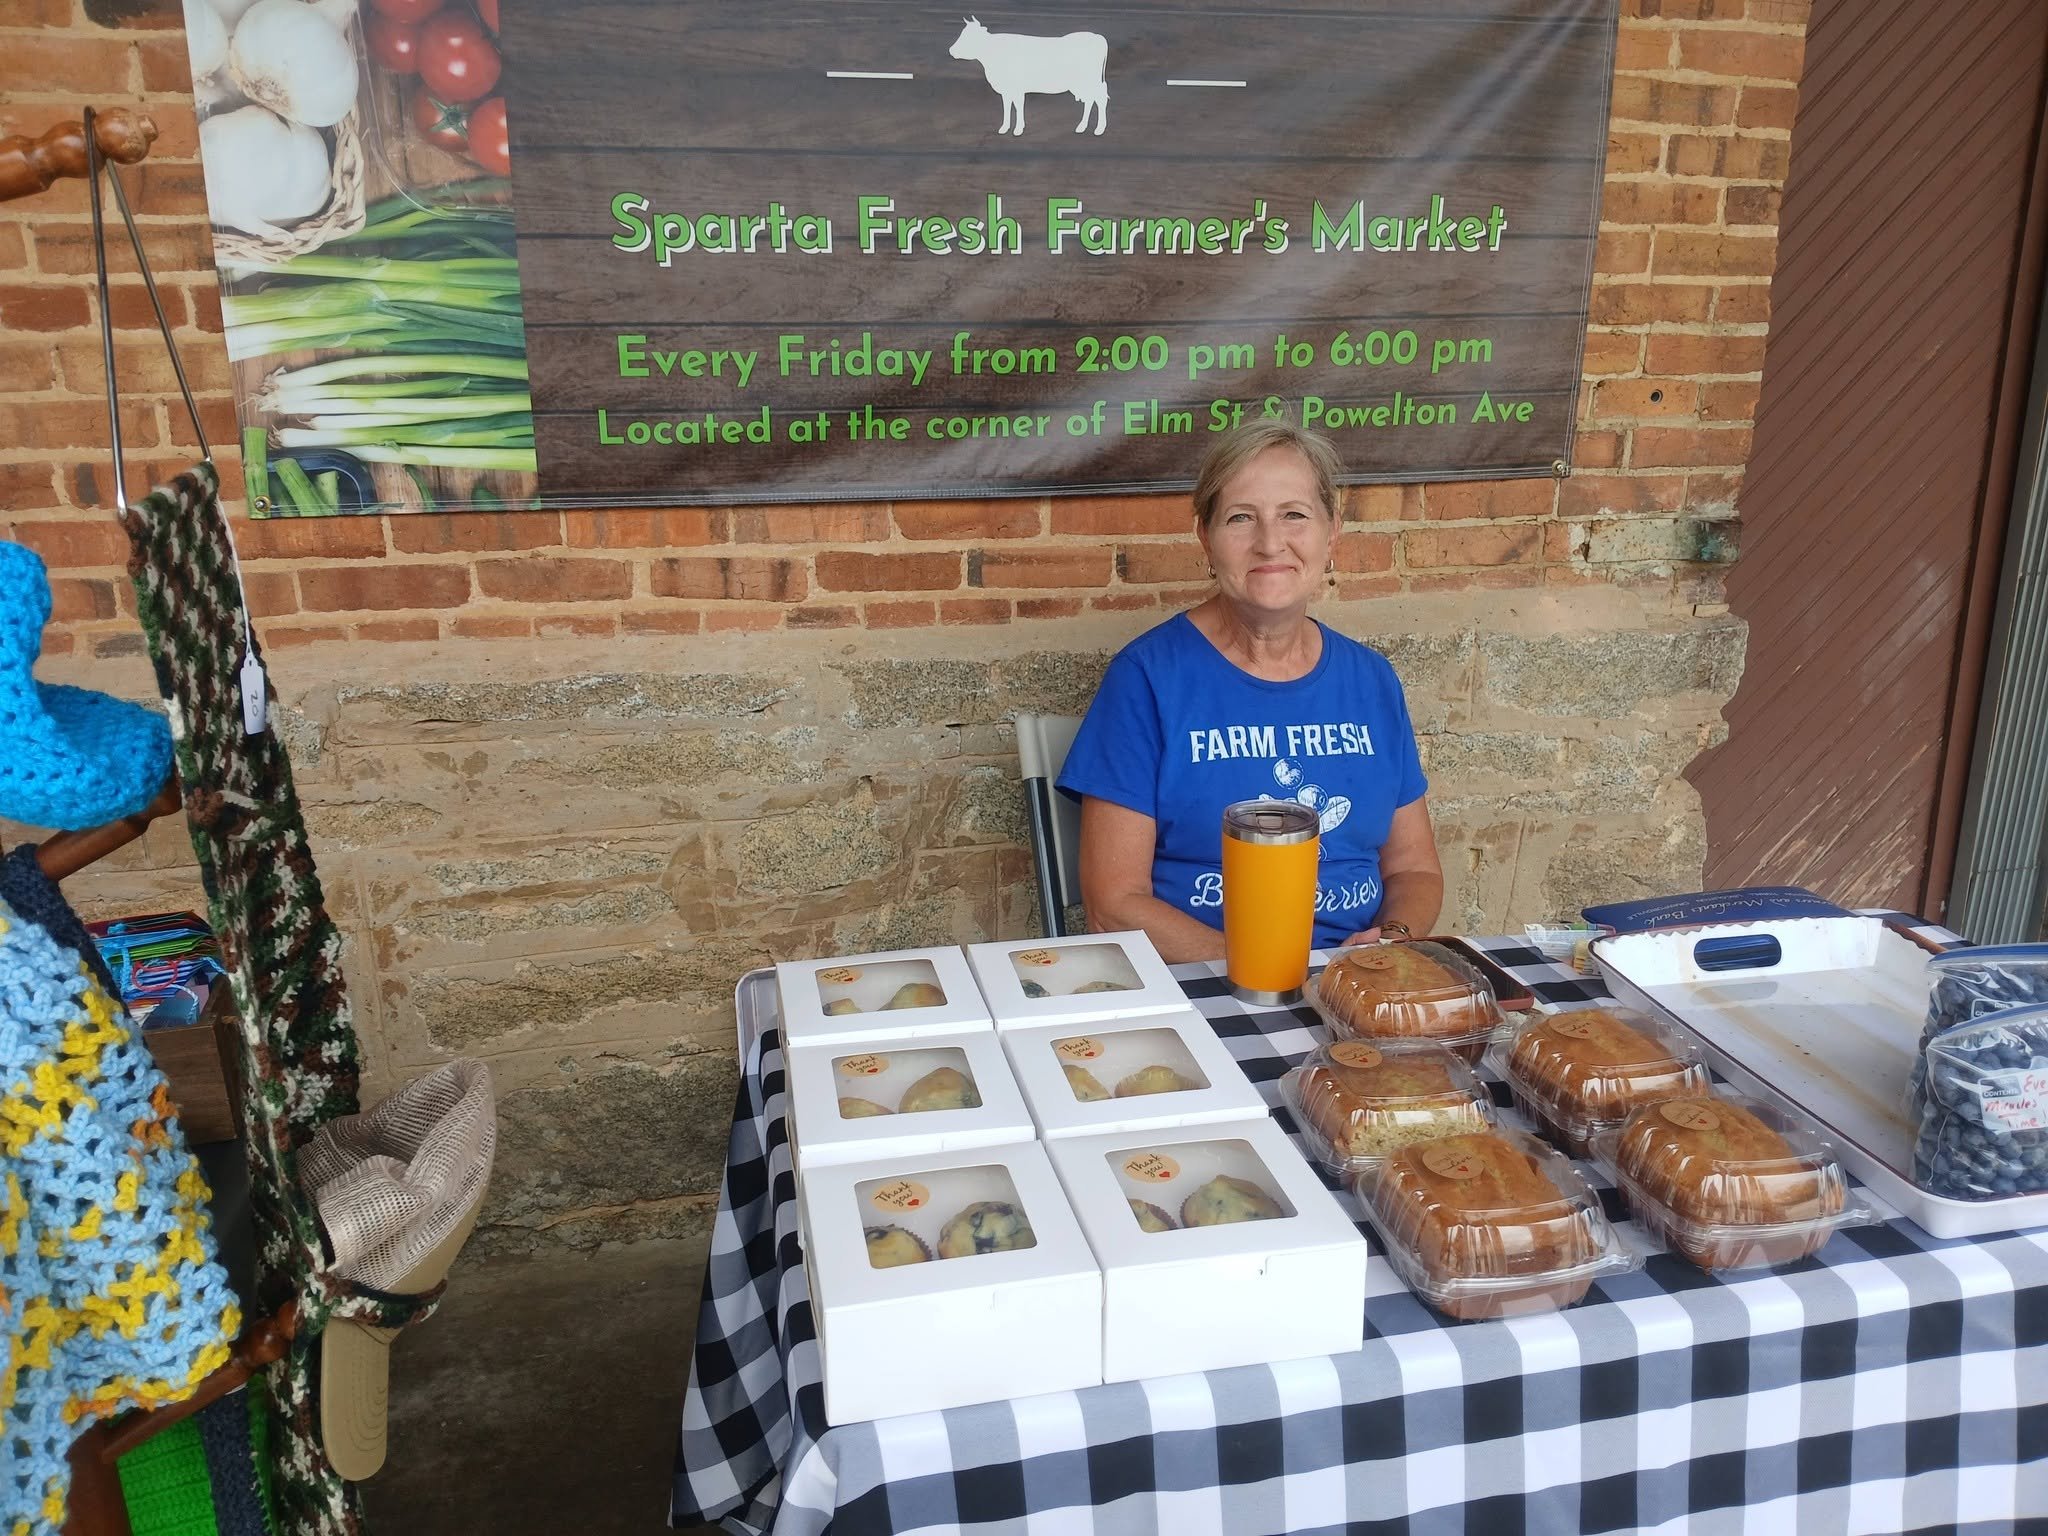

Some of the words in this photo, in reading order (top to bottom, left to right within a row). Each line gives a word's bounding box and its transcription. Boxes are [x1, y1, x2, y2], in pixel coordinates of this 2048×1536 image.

[610, 192, 832, 267] Sparta
[857, 193, 1022, 254] Fresh
[1047, 197, 1289, 255] Farmer's
[1311, 193, 1508, 252] Market
[617, 335, 758, 387] Every
[778, 332, 932, 386] Friday
[951, 332, 1056, 374] from
[1075, 335, 1169, 373] 2:00
[1188, 342, 1255, 380] pm
[1274, 334, 1315, 368] to
[1330, 330, 1419, 366] 6:00
[1431, 337, 1493, 374] pm
[598, 406, 771, 446] Located
[788, 411, 831, 441] at
[847, 404, 911, 441] the
[926, 411, 1050, 439] corner
[1065, 402, 1107, 436] of
[1123, 399, 1193, 436] Elm
[1207, 399, 1245, 432] St
[1302, 391, 1457, 430] Powelton
[1471, 391, 1534, 424] Ave
[1189, 725, 1277, 763] FARM
[1285, 722, 1375, 756] FRESH
[1190, 871, 1379, 914] Berries
[1644, 910, 1688, 929] Bank
[1058, 1038, 1091, 1052] Thank
[1126, 1153, 1160, 1172] Thank
[874, 1181, 911, 1202] Thank
